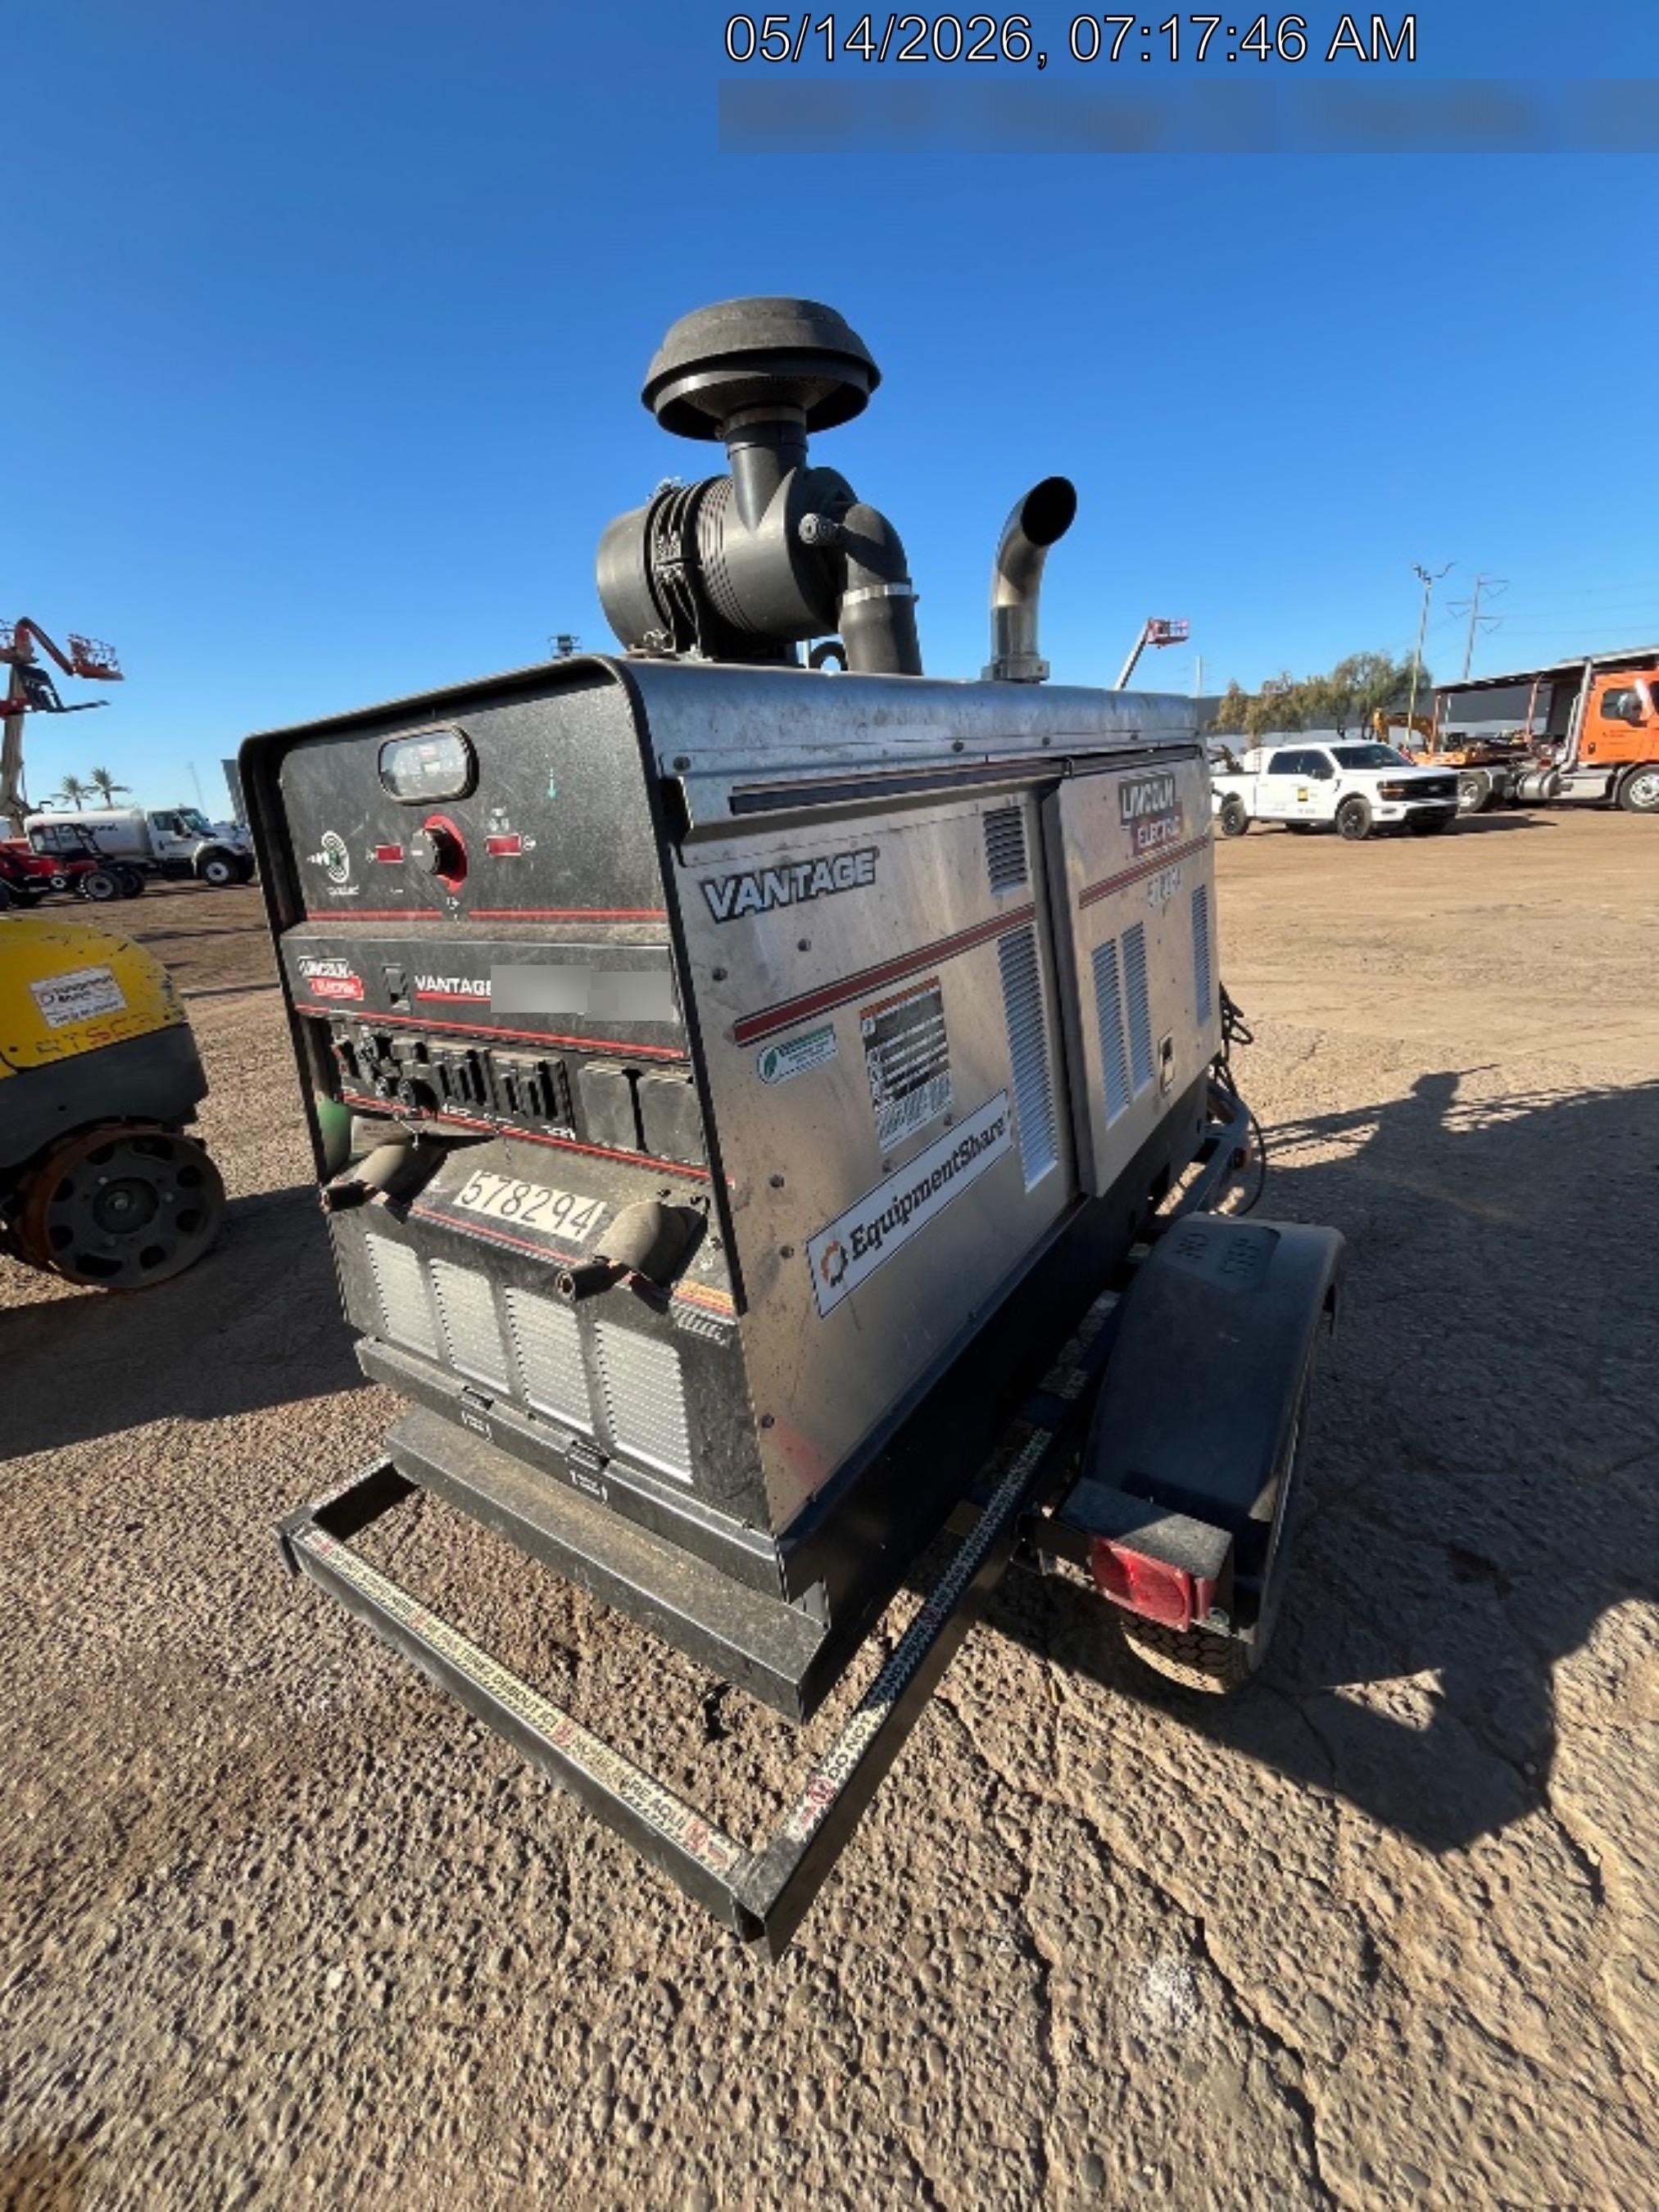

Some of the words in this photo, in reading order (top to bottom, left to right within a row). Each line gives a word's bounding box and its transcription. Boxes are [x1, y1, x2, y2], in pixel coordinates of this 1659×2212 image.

[1122, 778, 1174, 820] LINCOLN
[701, 847, 877, 923] VANTAGE
[461, 1173, 601, 1236] 578294
[850, 1117, 1005, 1261] EquipmentShare
[827, 1753, 850, 1779] DO
[844, 1716, 872, 1752] NOT
